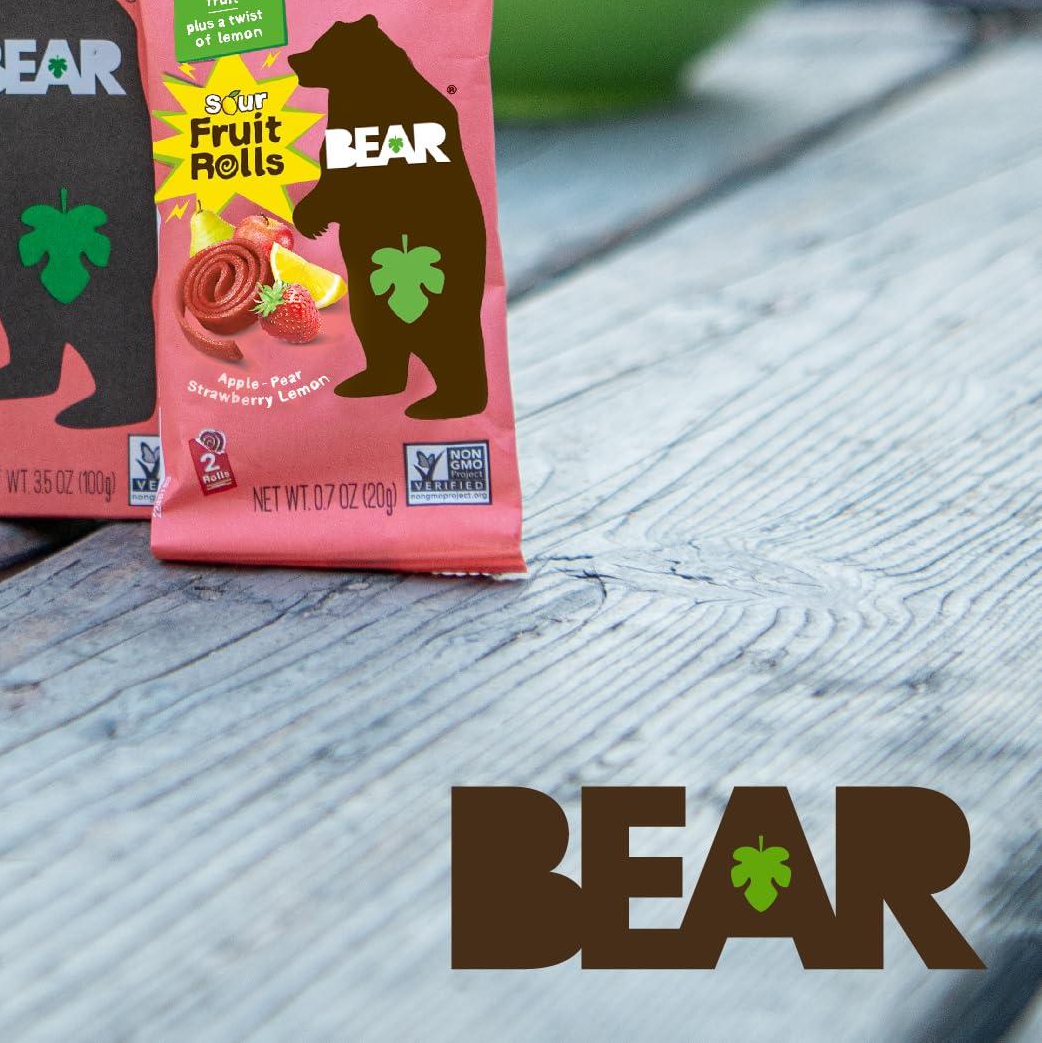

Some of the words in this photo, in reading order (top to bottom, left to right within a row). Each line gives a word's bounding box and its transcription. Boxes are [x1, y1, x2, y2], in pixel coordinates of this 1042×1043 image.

[186, 19, 215, 36] plus
[218, 18, 226, 28] a
[228, 9, 263, 26] twist
[195, 33, 211, 48] of
[217, 28, 263, 44] lemon
[189, 113, 282, 148] Fruit
[325, 122, 451, 170] BEAR
[190, 146, 285, 181] Rolls
[187, 380, 273, 408] Strawberry
[278, 374, 331, 402] Lemon
[200, 453, 220, 472] 2
[450, 449, 482, 460] NON
[450, 459, 483, 470] GMO
[57, 469, 74, 495] OZ
[78, 470, 116, 503] (100g)
[202, 471, 230, 484] Rolls
[414, 480, 484, 491] VERIFIED
[451, 469, 483, 480] Project
[253, 485, 279, 513] NET
[286, 484, 311, 511] WT.
[314, 483, 335, 511] 0.7
[339, 483, 358, 509] OZ
[362, 482, 398, 517] (20g)
